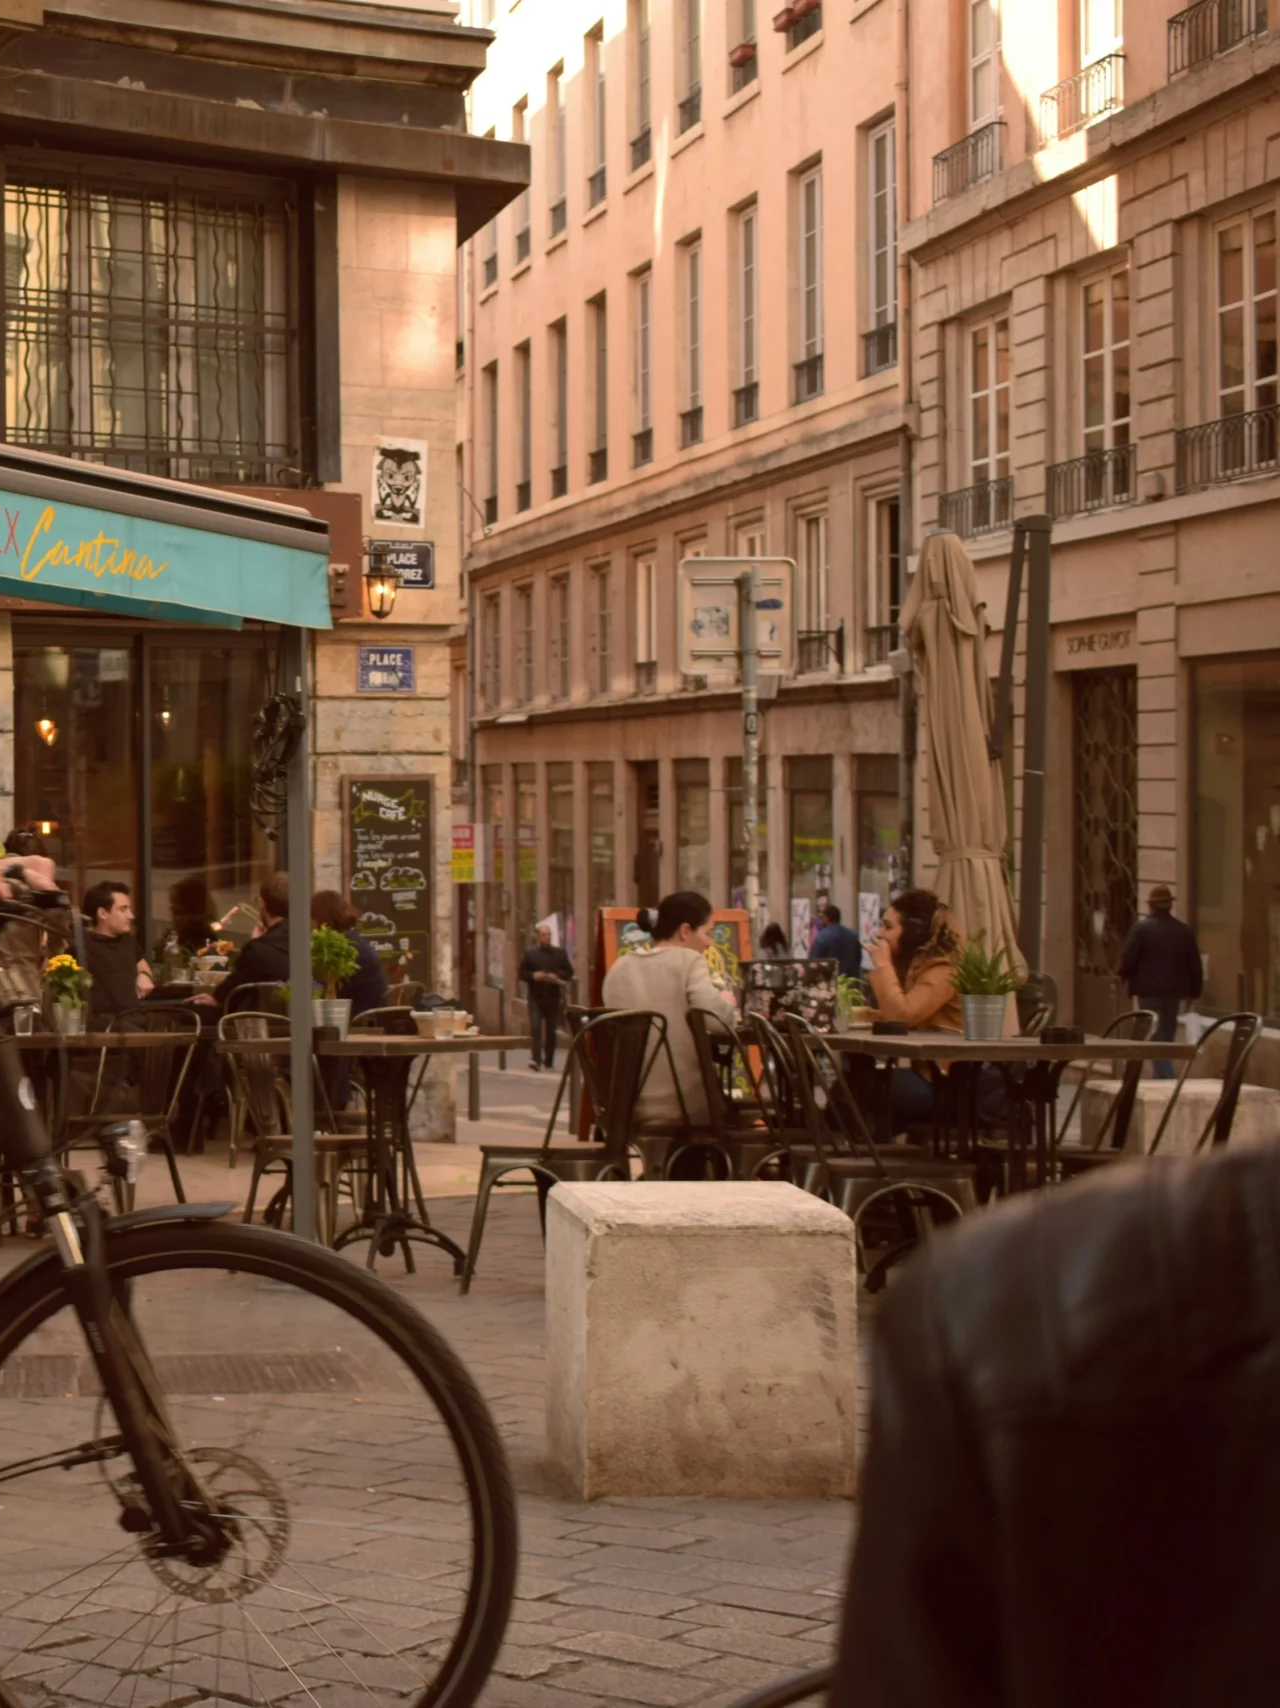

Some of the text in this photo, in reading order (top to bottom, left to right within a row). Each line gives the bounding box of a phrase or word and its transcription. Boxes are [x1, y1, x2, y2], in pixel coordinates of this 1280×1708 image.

[20, 505, 168, 581] Cantina
[386, 552, 418, 565] PLACE
[368, 653, 403, 666] PLACE
[362, 791, 399, 808] NUAGE
